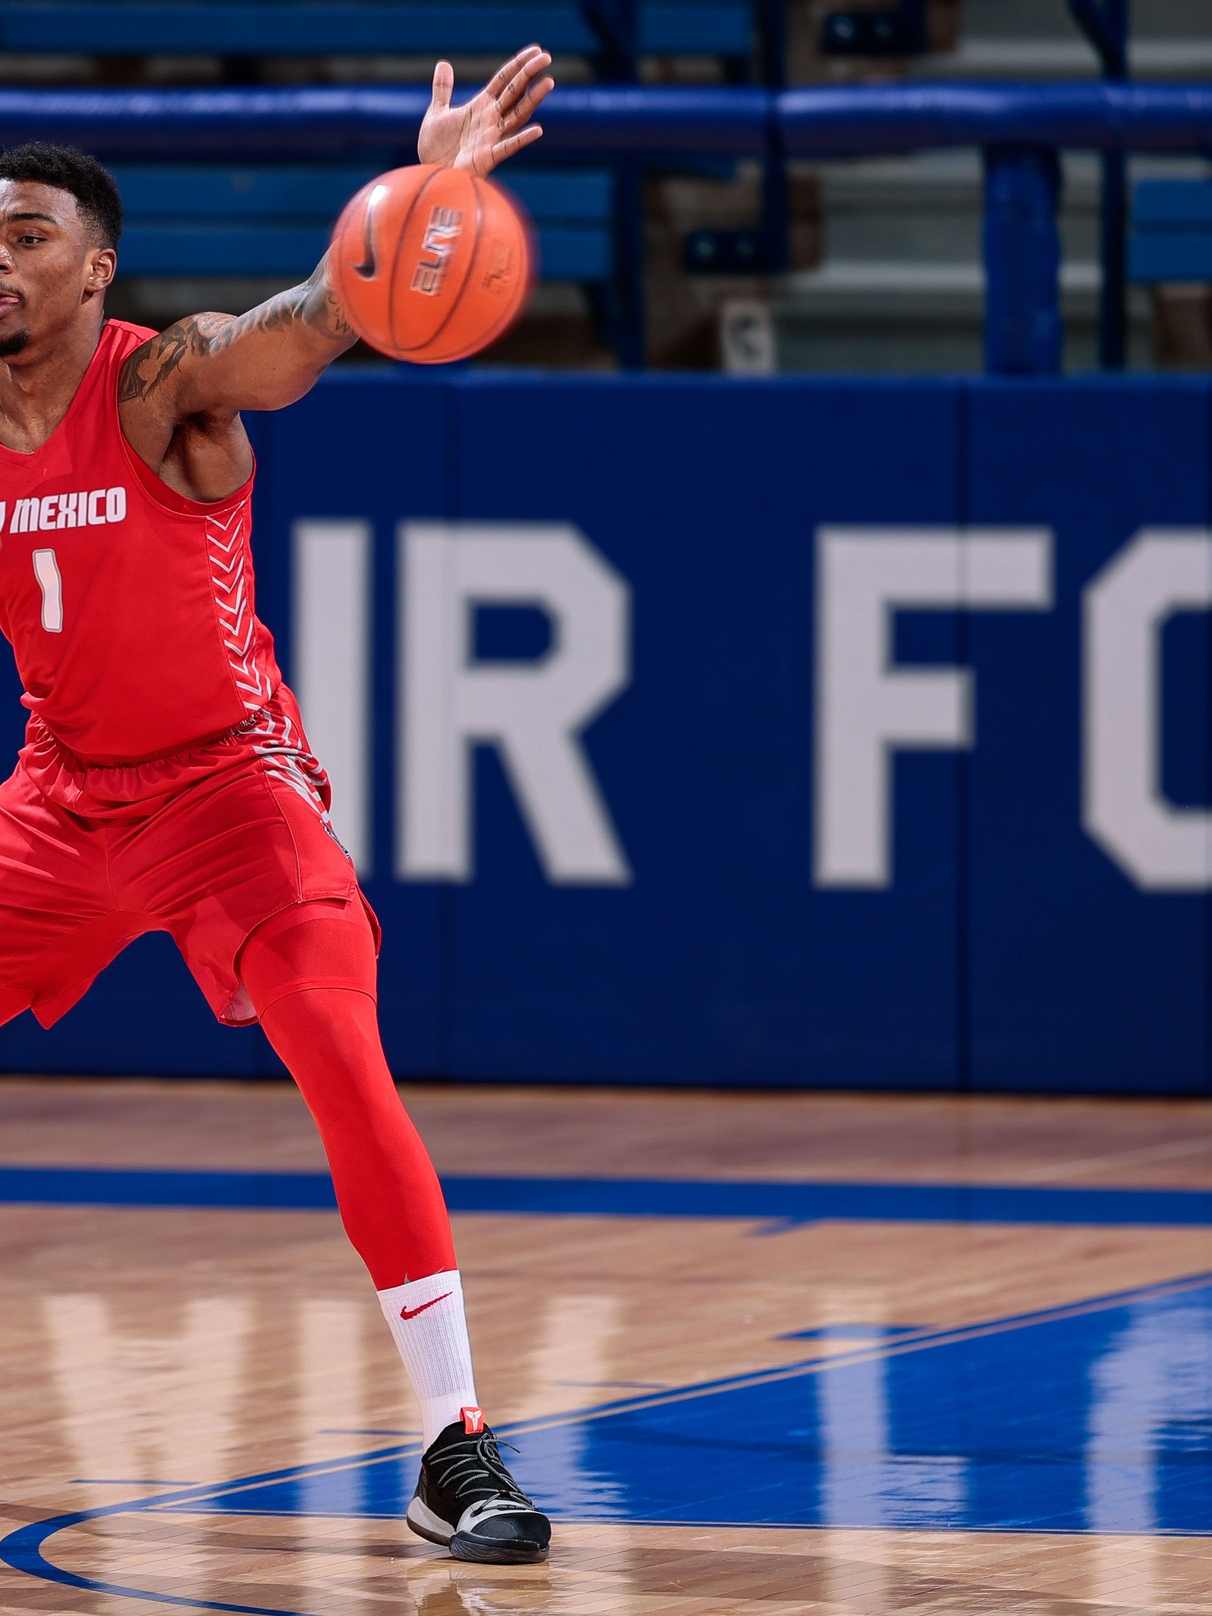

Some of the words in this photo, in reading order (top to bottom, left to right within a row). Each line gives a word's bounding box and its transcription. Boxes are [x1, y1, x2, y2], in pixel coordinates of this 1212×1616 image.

[410, 205, 464, 297] ELITE
[9, 486, 128, 534] MEXICO
[32, 547, 63, 634] 1
[292, 517, 634, 886] IR
